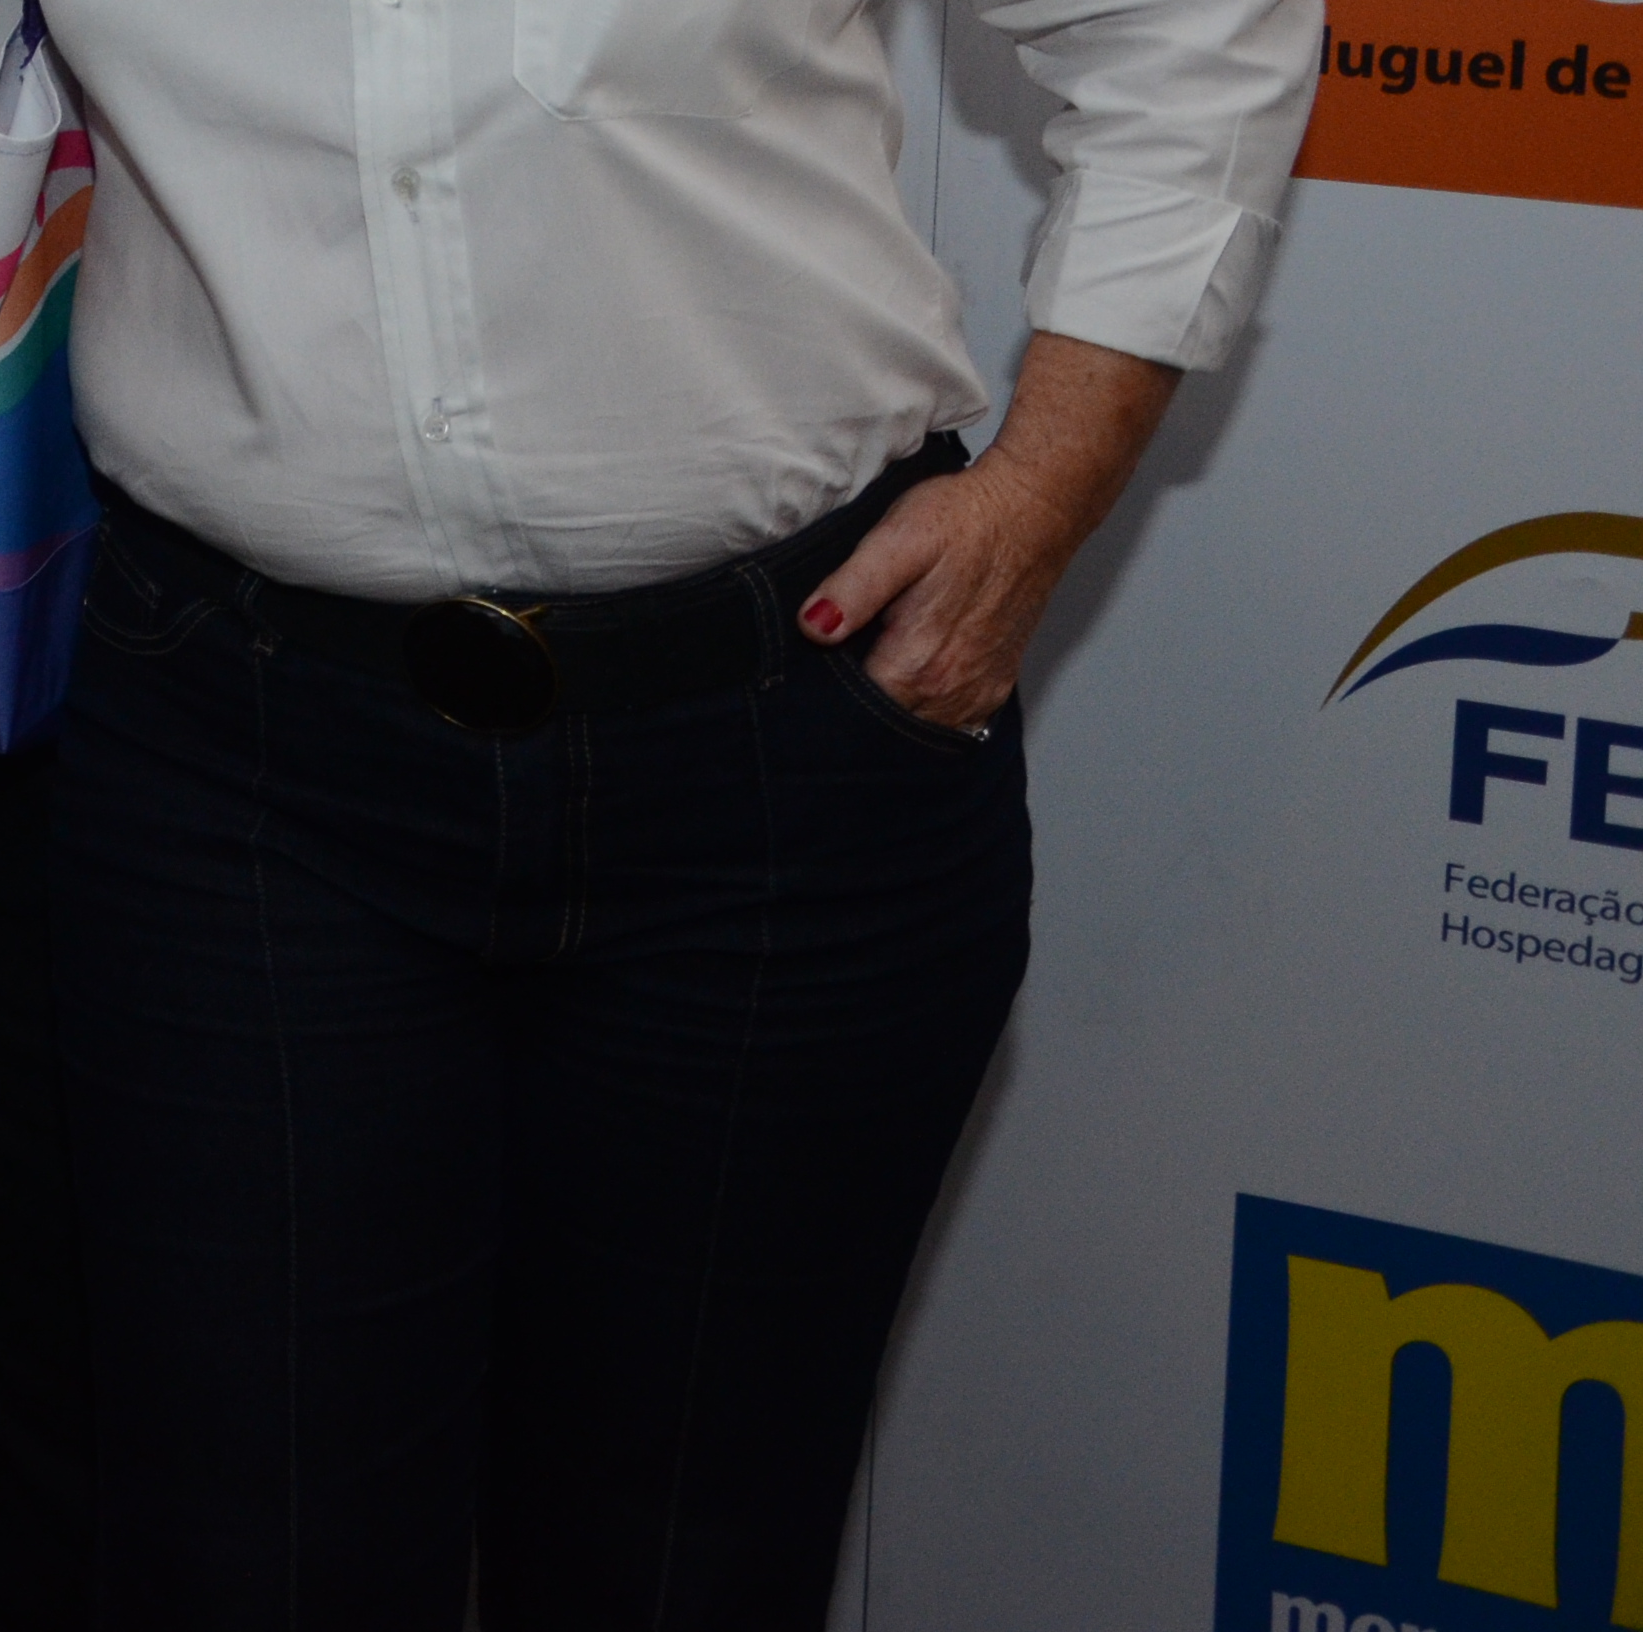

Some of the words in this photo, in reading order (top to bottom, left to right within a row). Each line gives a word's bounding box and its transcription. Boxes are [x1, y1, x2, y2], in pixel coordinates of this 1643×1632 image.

[1320, 25, 1525, 95] luguel
[1545, 44, 1632, 100] de
[1443, 863, 1643, 926] Federação
[1440, 913, 1643, 984] Hospedag
